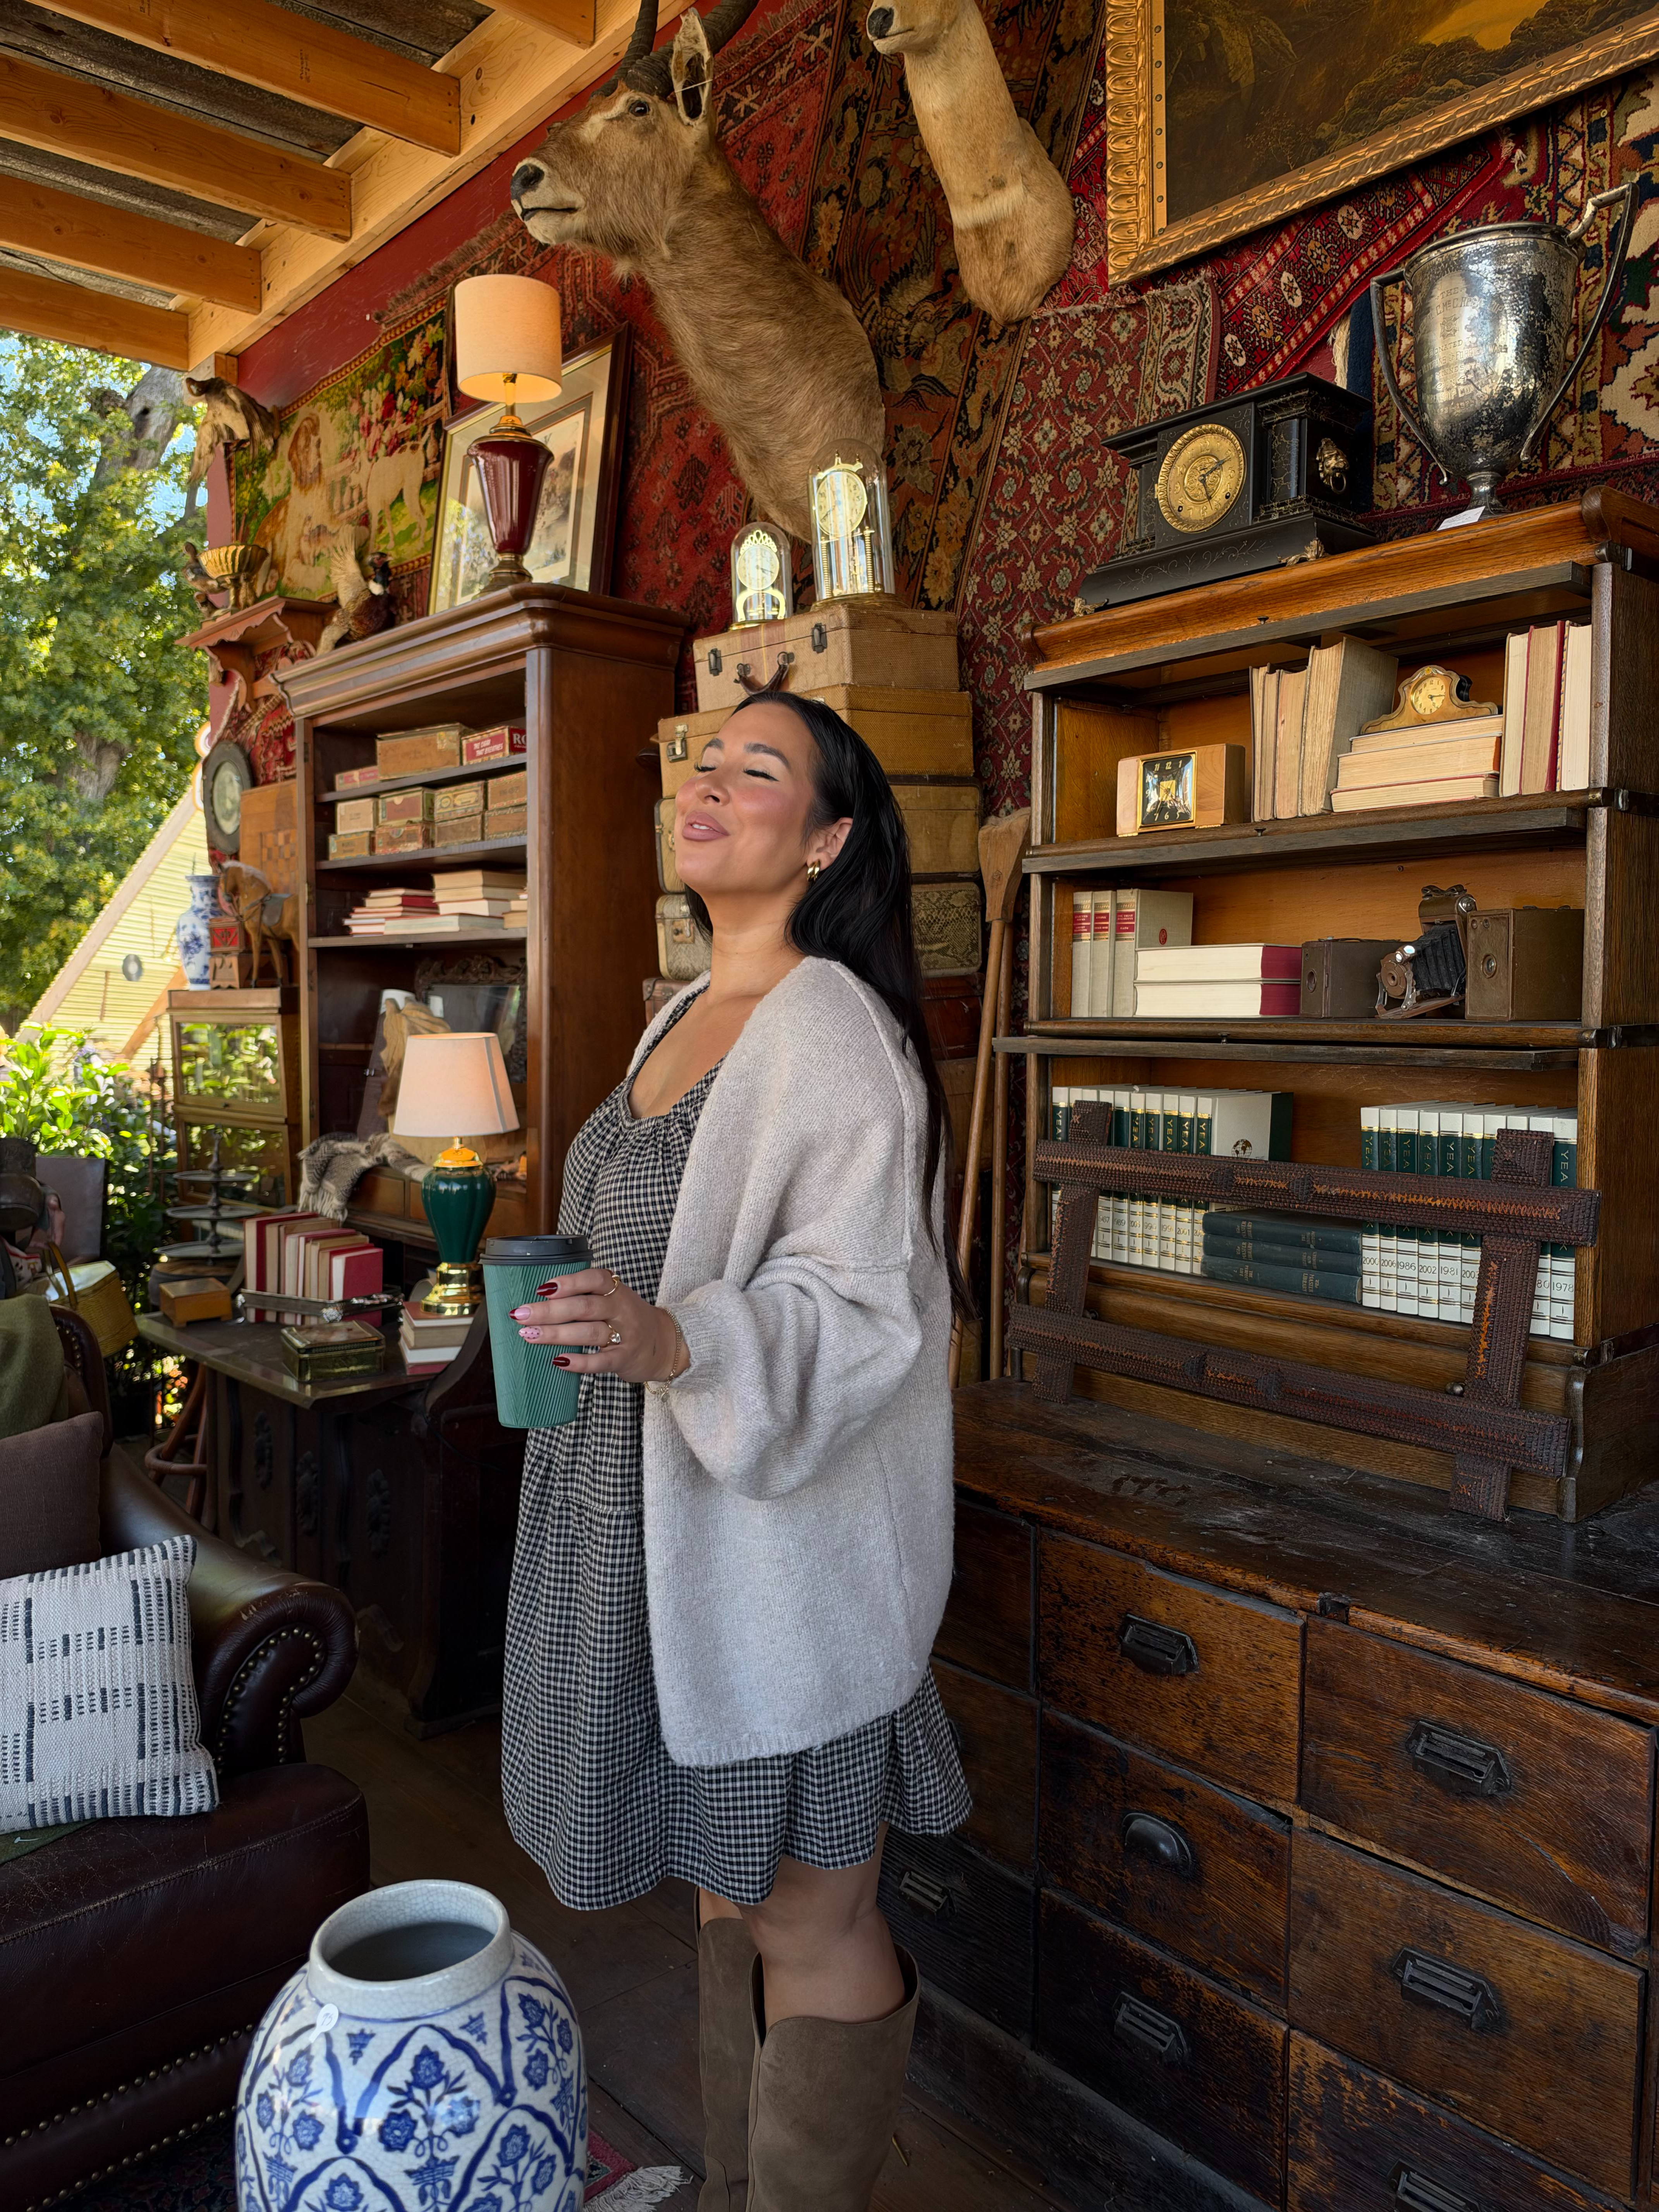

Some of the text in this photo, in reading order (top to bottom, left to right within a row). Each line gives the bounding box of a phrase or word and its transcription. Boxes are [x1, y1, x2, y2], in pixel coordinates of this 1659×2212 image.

[1440, 287, 1459, 300] THE
[1154, 763, 1160, 771] 11
[1165, 761, 1172, 769] 12
[1178, 760, 1182, 768] 1
[1164, 811, 1169, 820] 6
[1177, 1227, 1190, 1236] 2001
[1381, 1259, 1396, 1267] 2006
[1397, 1261, 1416, 1271] 1986
[1419, 1264, 1437, 1274] 2002
[1441, 1266, 1458, 1276] 1981
[1553, 1281, 1574, 1293] 1978
